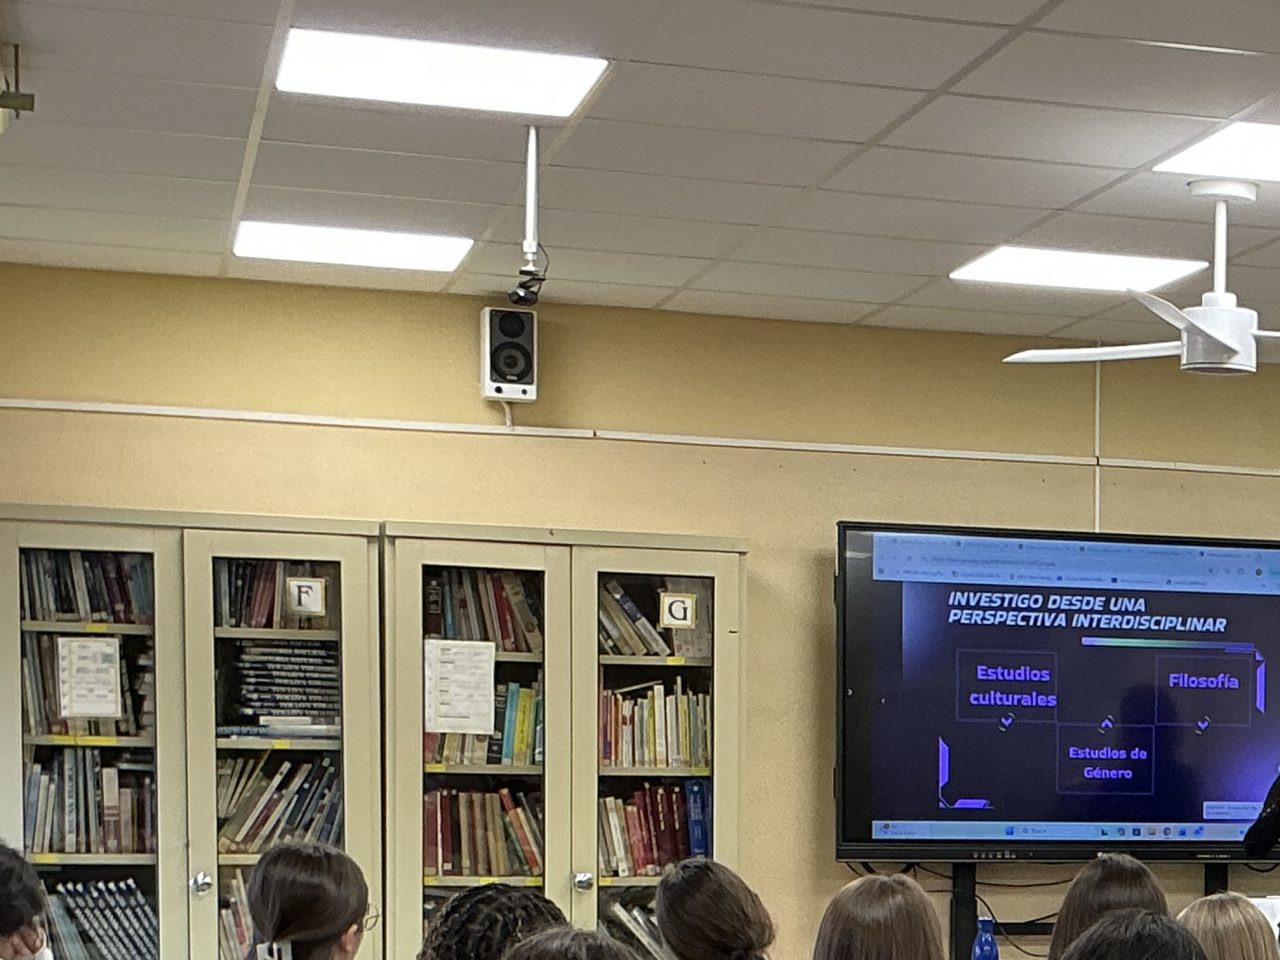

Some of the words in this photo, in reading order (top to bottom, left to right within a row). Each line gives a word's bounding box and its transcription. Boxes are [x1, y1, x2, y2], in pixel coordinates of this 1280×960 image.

[296, 584, 313, 608] F
[949, 591, 1042, 609] INVESTIGO
[1047, 595, 1105, 611] DESDE
[1109, 597, 1146, 612] UNA
[667, 599, 688, 621] G
[948, 609, 1067, 627] PERSPECTIVA
[1071, 613, 1227, 632] INTERDISCIPLINAR
[976, 665, 1051, 681] Estudios
[1169, 672, 1240, 689] Filosofía
[969, 690, 1057, 707] culturales
[1069, 746, 1127, 759] Estudios
[1130, 747, 1148, 759] de
[1083, 766, 1133, 779] Género
